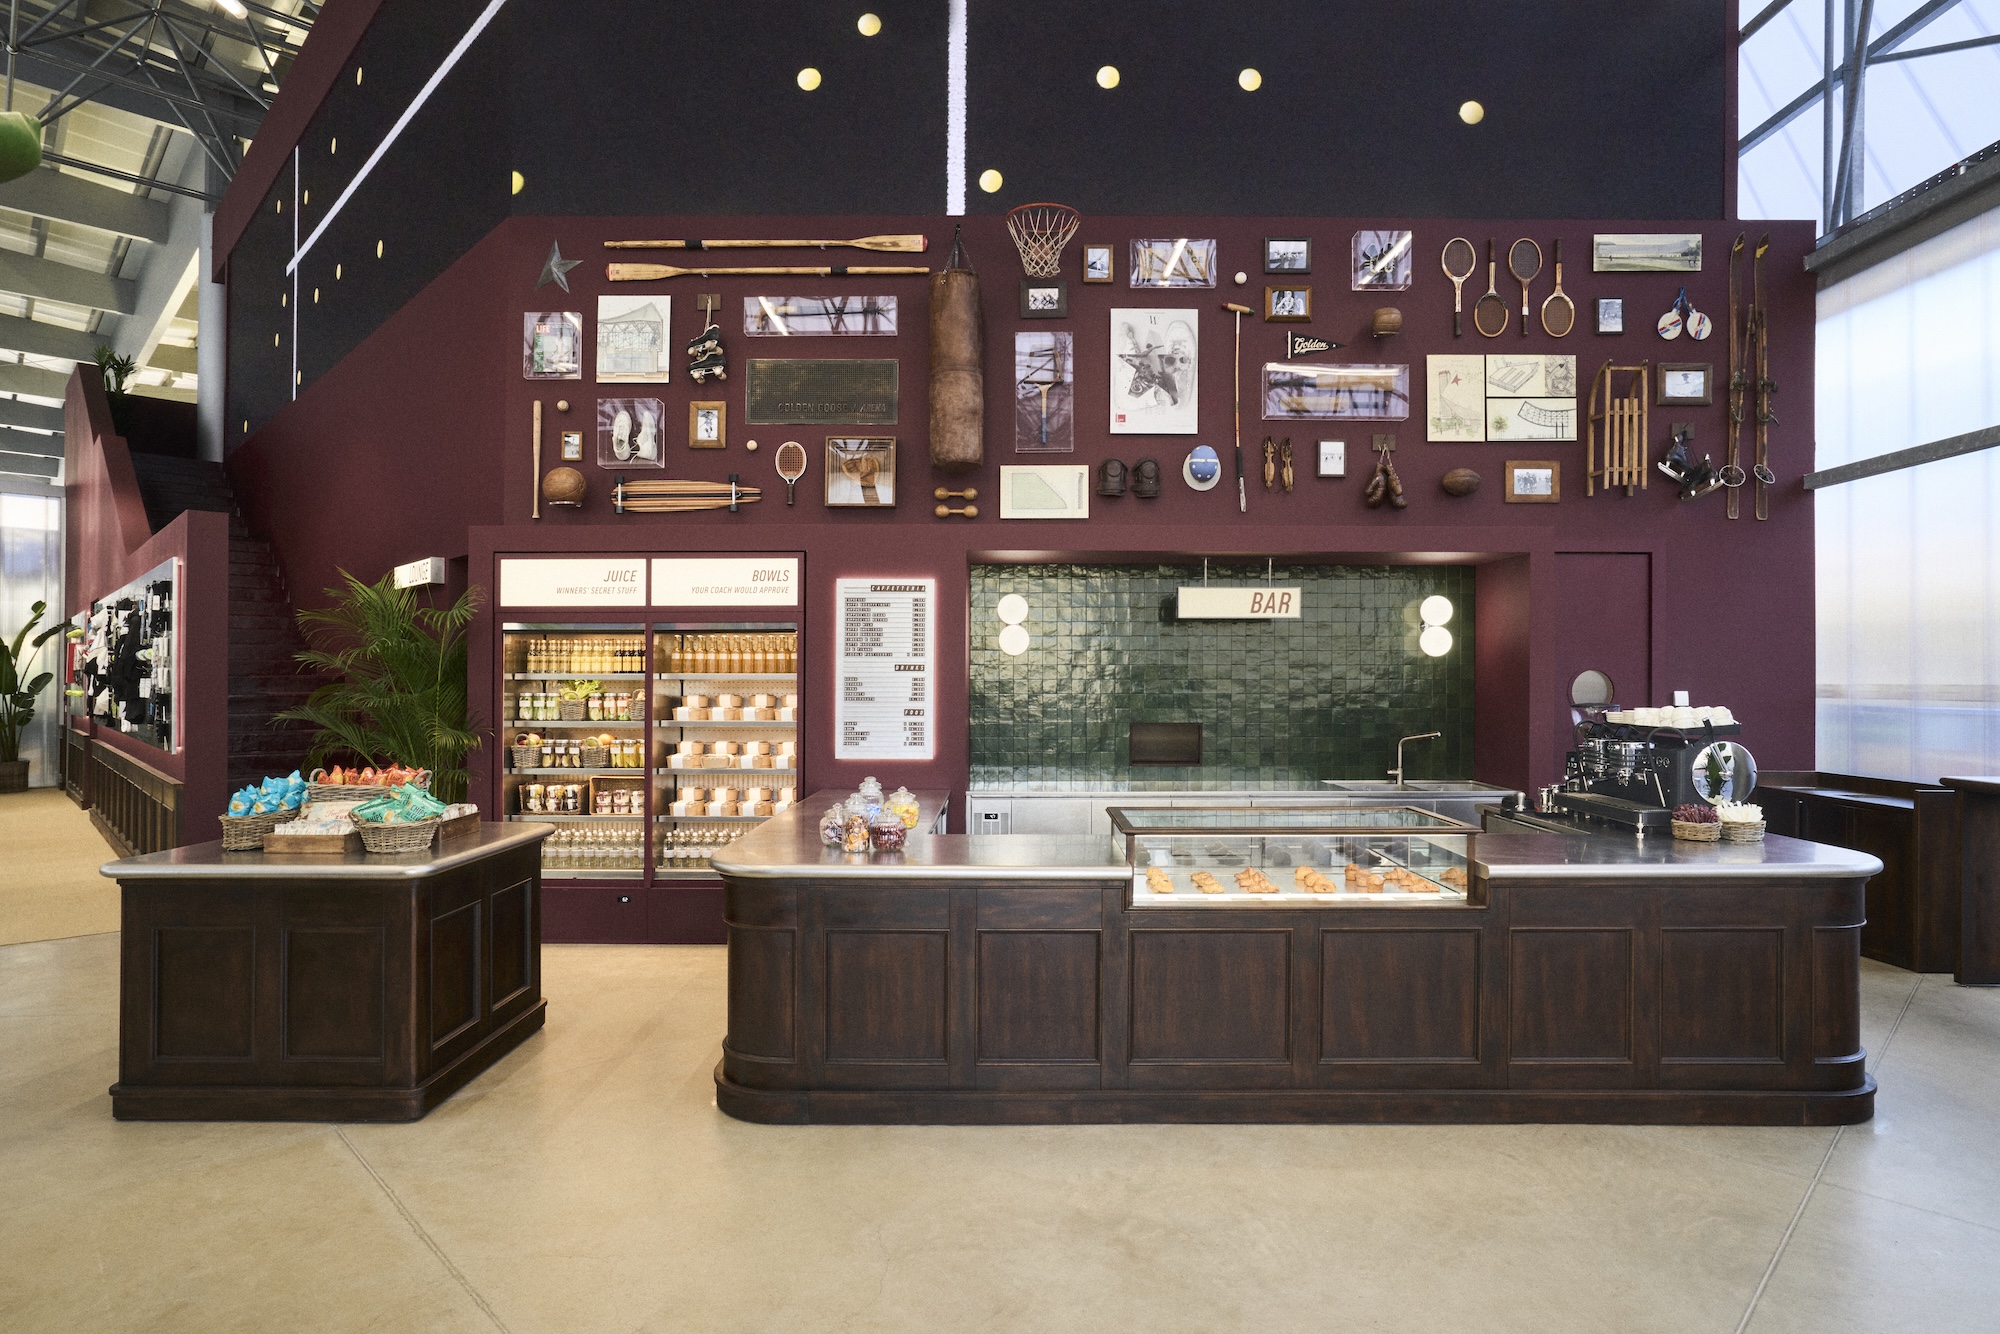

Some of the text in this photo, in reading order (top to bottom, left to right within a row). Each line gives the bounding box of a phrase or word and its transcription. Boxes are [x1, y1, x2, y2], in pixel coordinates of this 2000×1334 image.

[536, 325, 551, 334] LIFE
[1294, 337, 1329, 354] Golden
[778, 403, 814, 412] GOLDEN
[818, 403, 848, 412] GOOSE
[860, 403, 887, 412] ARENA
[603, 570, 638, 582] JUICE
[752, 569, 790, 582] BOWLS
[556, 586, 638, 594] WINNERS' SECRET STUFF
[691, 586, 790, 594] YOUR COACH WOULD APPROVE
[1250, 592, 1292, 614] BAR
[410, 804, 427, 817] CHIPS
